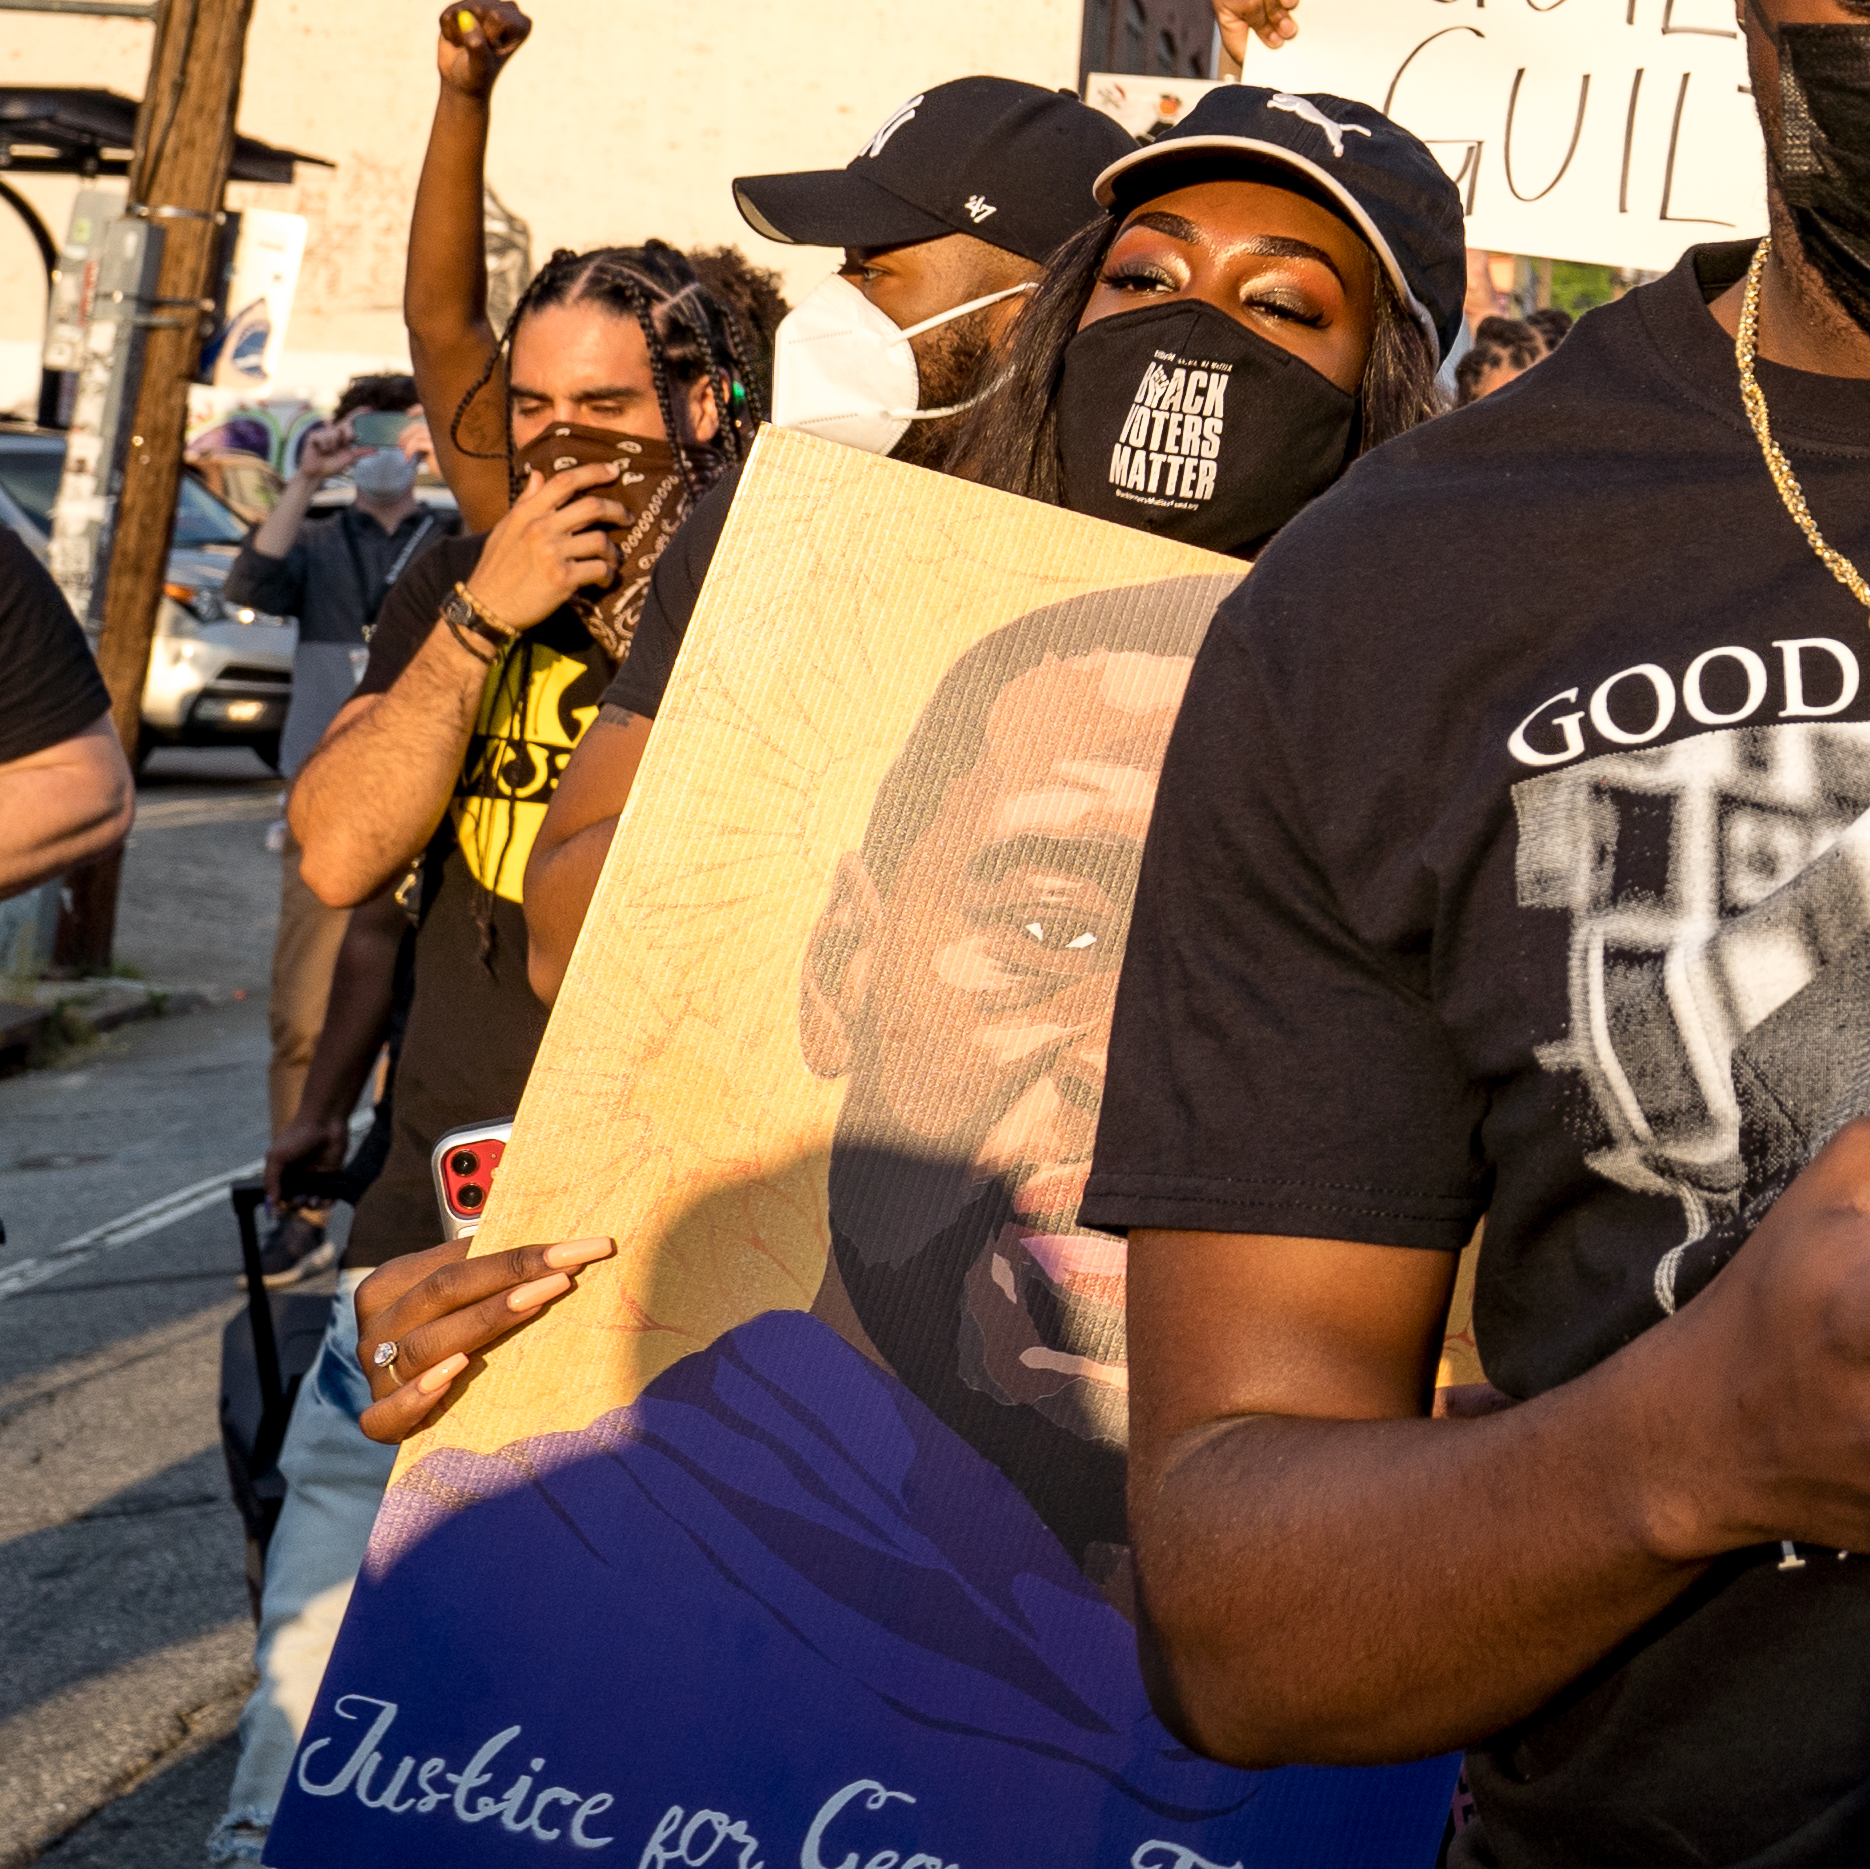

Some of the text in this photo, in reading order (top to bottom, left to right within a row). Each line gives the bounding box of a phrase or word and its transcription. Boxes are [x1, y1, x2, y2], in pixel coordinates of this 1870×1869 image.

[1383, 26, 1752, 228] GUIL
[1108, 442, 1217, 500] MATTER
[1119, 402, 1223, 459] VOTERS
[1506, 636, 1859, 767] GOOD
[297, 1693, 615, 1850] Justice
